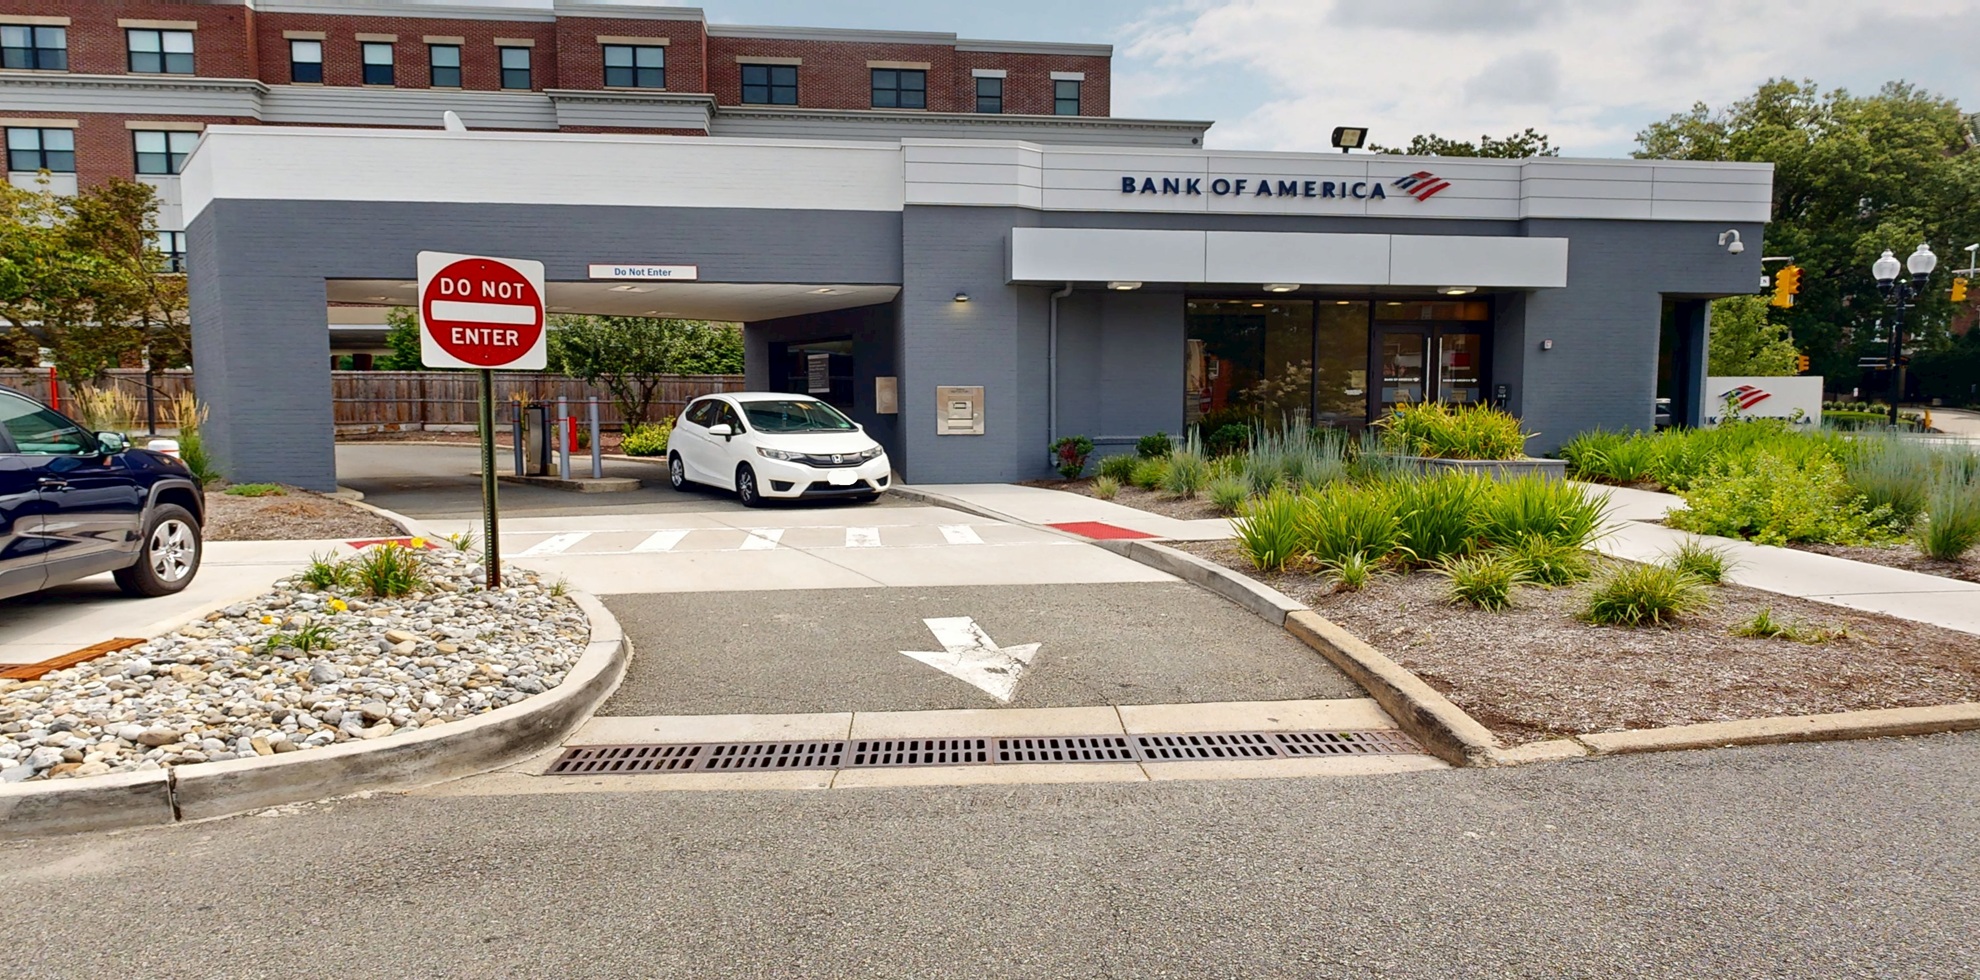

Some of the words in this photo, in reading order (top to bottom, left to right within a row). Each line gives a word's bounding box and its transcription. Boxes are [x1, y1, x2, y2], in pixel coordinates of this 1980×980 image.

[1121, 176, 1202, 195] BANK
[1211, 178, 1248, 196] OF
[1255, 179, 1387, 199] AMERICA
[614, 267, 627, 276] Do
[629, 267, 645, 276] Not
[647, 268, 671, 277] Enter
[440, 277, 472, 296] DO
[481, 280, 525, 299] NOT
[451, 327, 519, 346] ENTER
